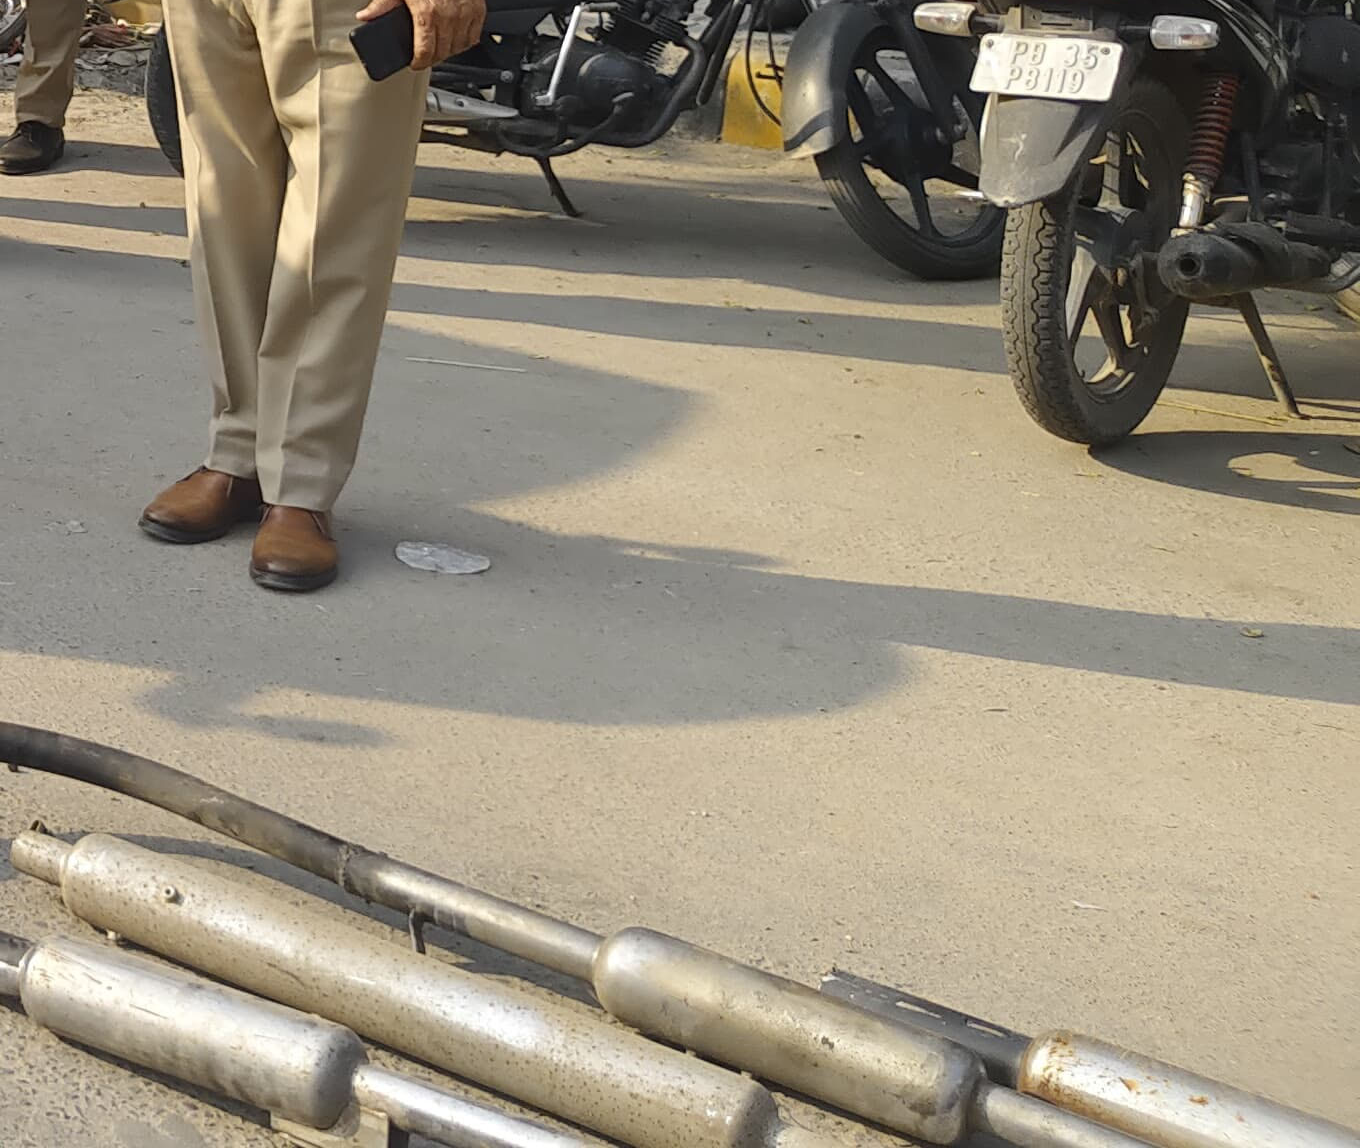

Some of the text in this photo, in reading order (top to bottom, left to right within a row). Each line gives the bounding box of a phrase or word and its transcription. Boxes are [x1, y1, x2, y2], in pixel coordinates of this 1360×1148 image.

[1010, 40, 1100, 71] PB 35
[1004, 66, 1086, 95] P8119
